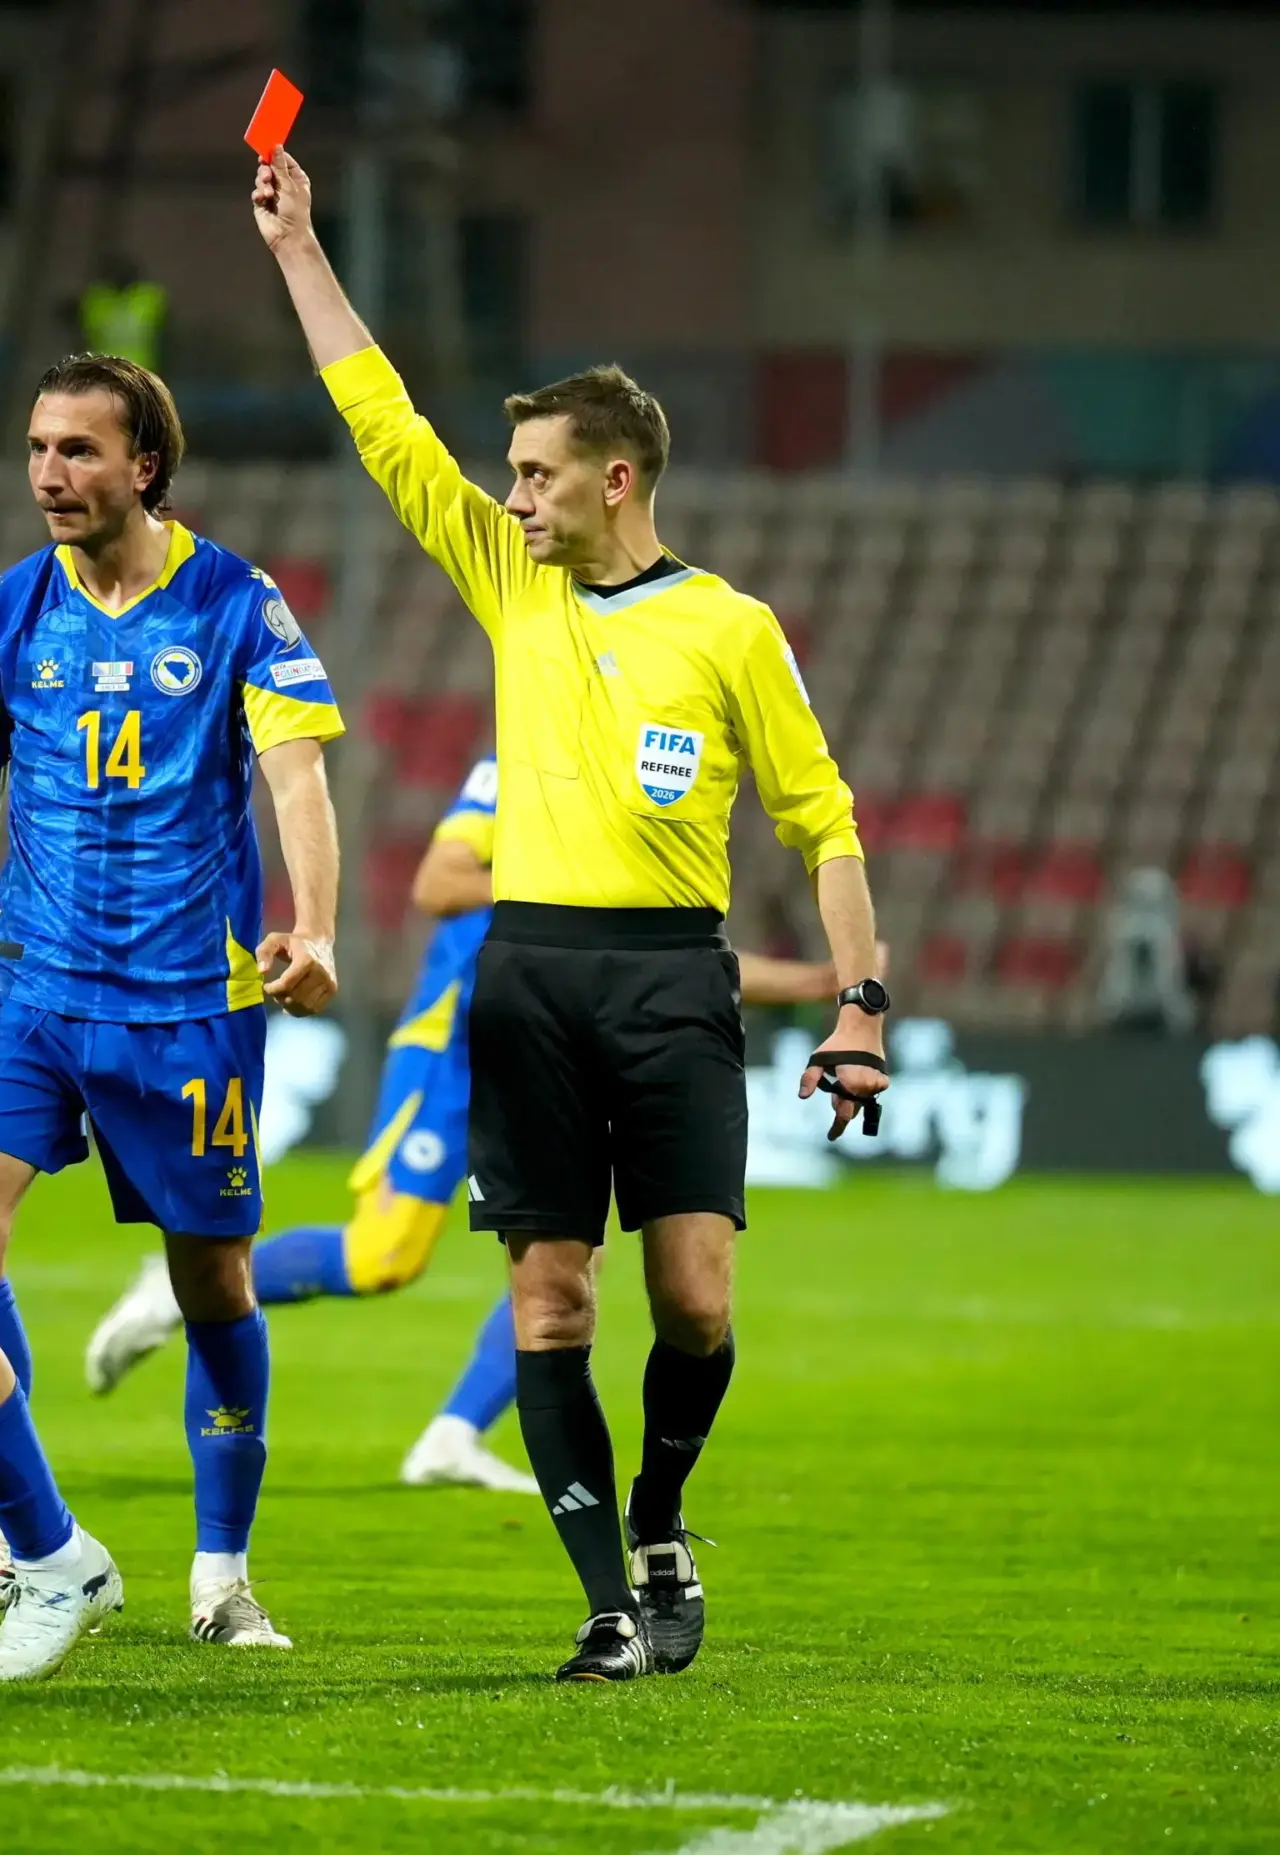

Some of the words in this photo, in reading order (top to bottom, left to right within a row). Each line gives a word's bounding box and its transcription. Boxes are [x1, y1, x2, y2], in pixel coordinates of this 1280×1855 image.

[31, 680, 65, 689] KELME
[76, 710, 146, 789] 14
[644, 730, 696, 756] FIFA
[640, 760, 693, 778] REFEREE
[651, 788, 675, 801] 2026
[181, 1077, 248, 1157] 14
[220, 1187, 253, 1197] KELME
